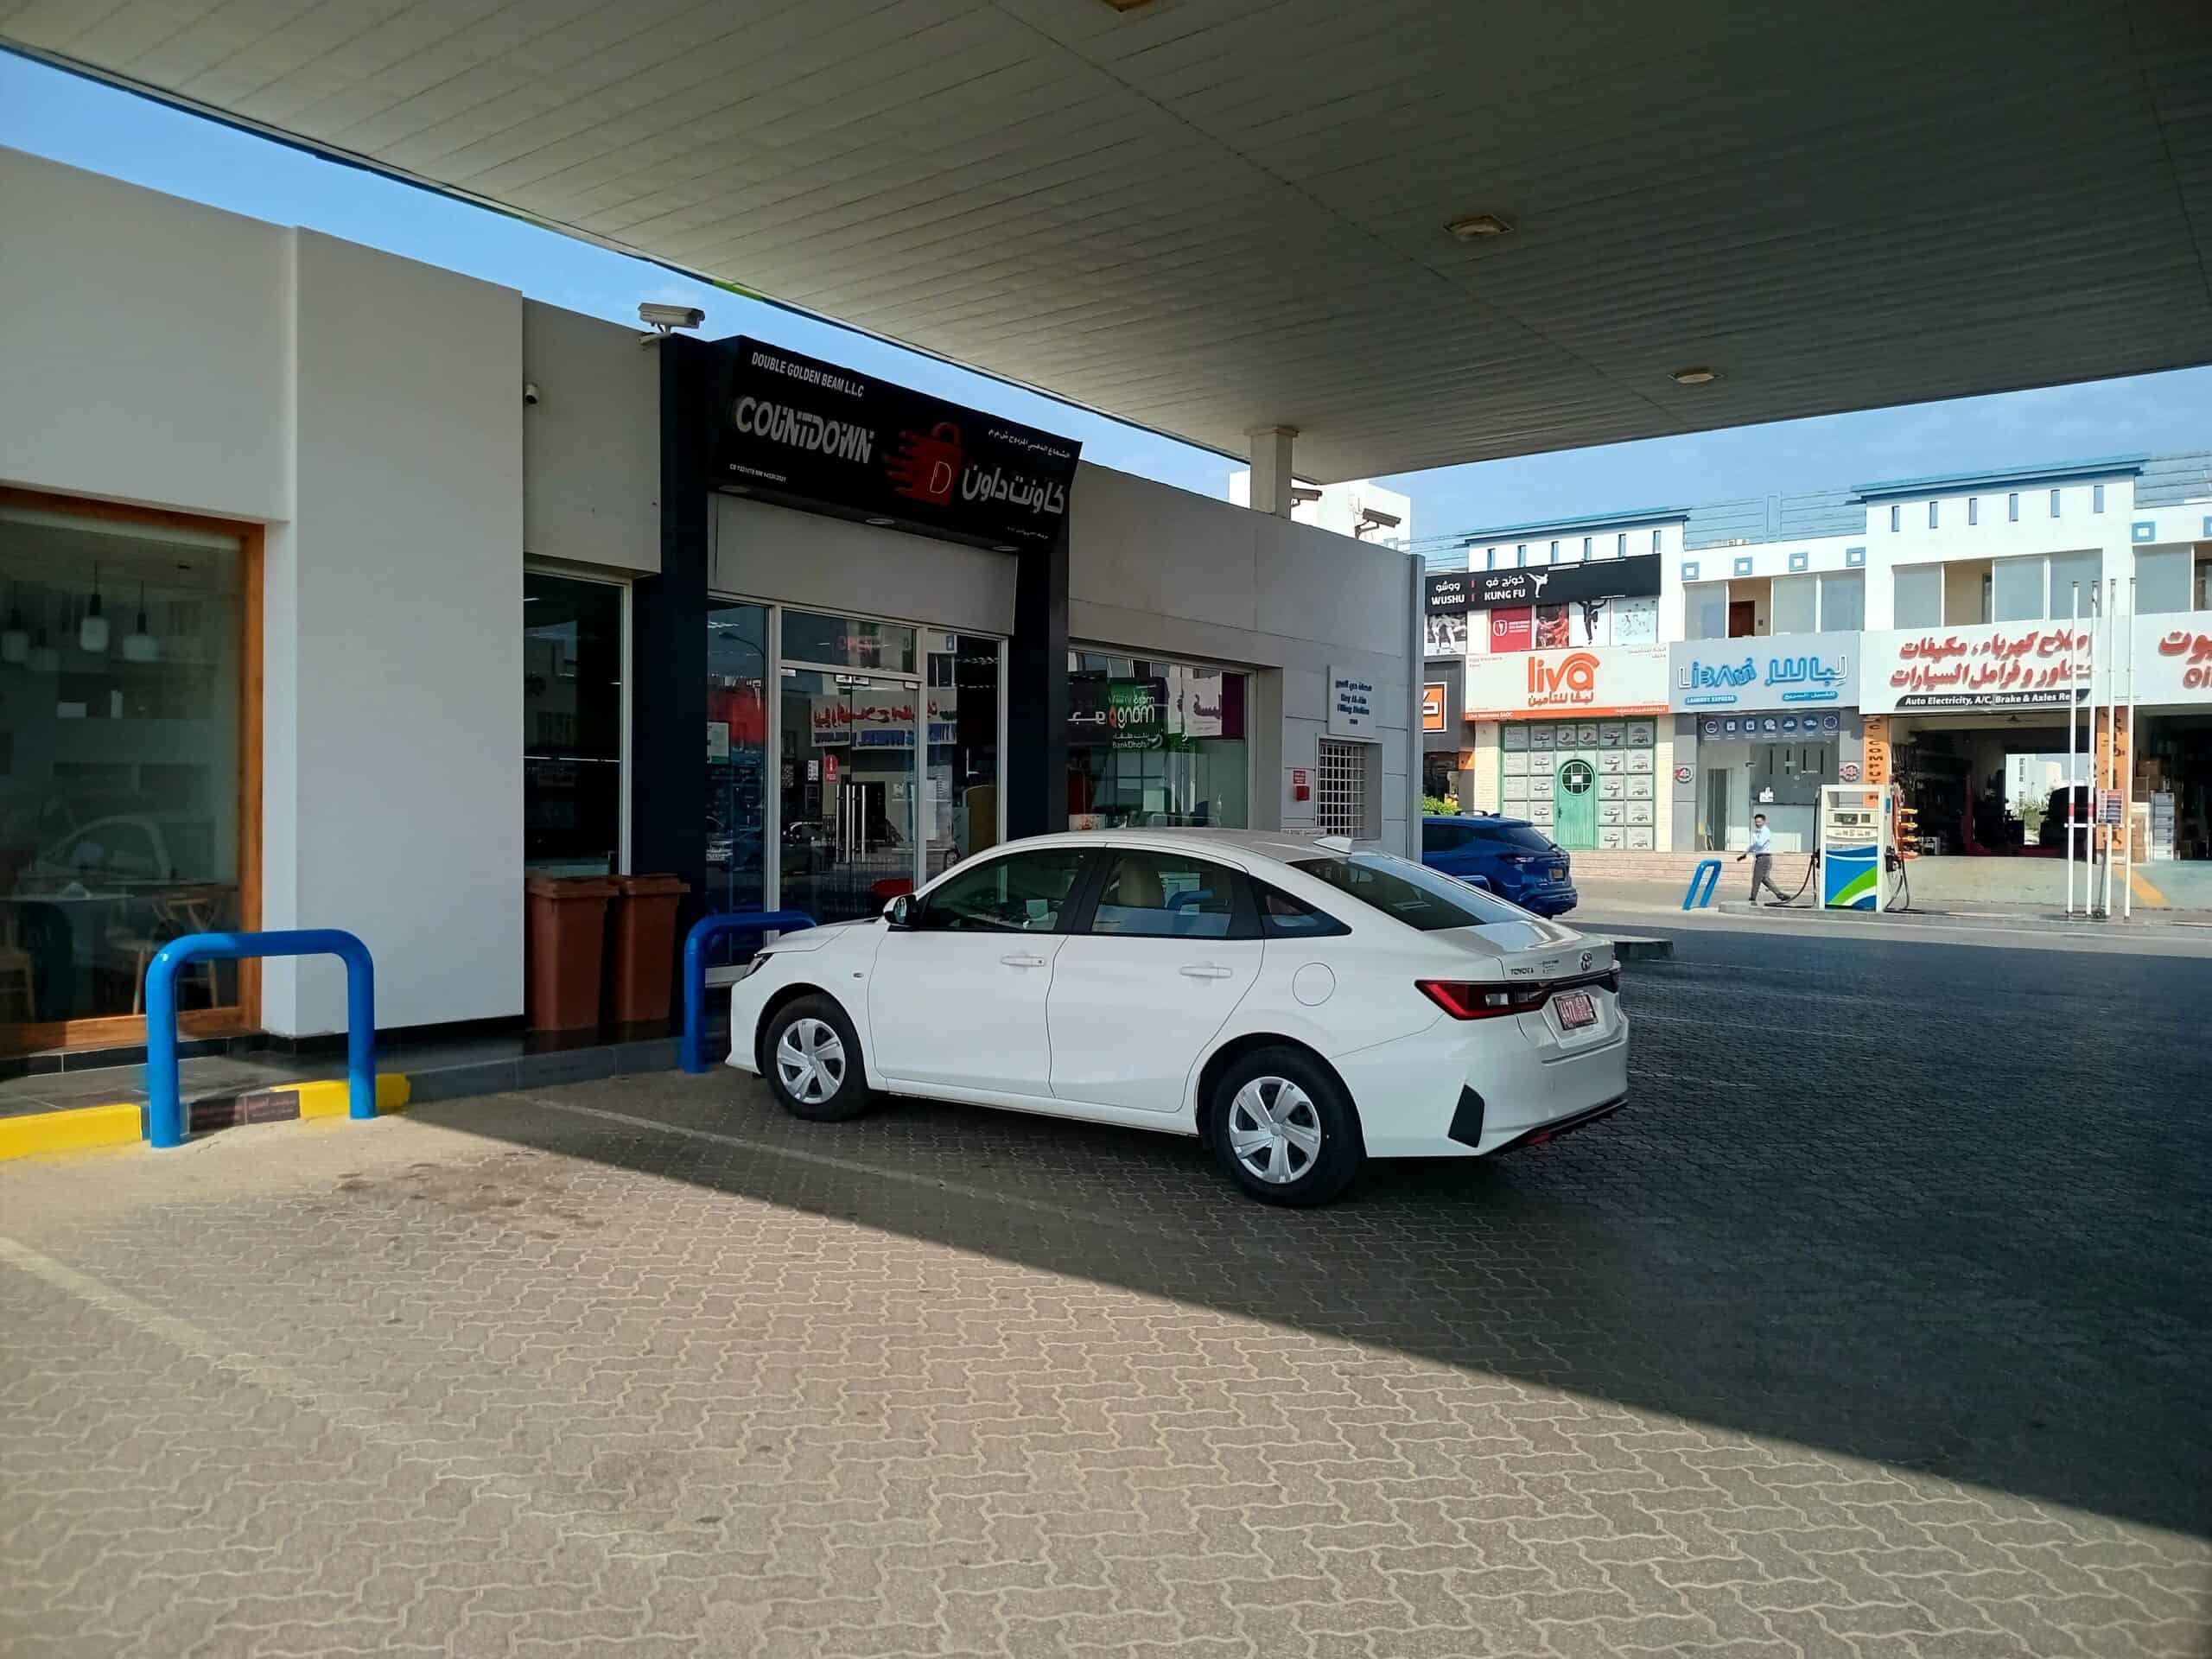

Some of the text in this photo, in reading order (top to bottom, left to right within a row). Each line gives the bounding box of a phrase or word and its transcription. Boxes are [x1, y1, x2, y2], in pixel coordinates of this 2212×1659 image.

[751, 352, 787, 374] DOUBLE
[787, 363, 821, 385] GOLDEN
[821, 372, 844, 391] BEAM
[736, 397, 874, 464] COUNTDOWN
[930, 461, 951, 494] D
[962, 465, 1065, 514] كاونت داون
[1484, 588, 1526, 601] KUNG FU
[1486, 577, 1499, 588] فو
[1431, 594, 1465, 606] WUSHU
[1900, 636, 1967, 664] مكيفات
[1528, 652, 1600, 693] liva
[1905, 697, 1926, 706] Auto
[1928, 696, 1973, 706] Electricity,
[1995, 695, 2021, 704] Brake
[2023, 694, 2030, 702] &
[2032, 692, 2056, 702] Axles
[1510, 967, 1535, 976] TOYOTA
